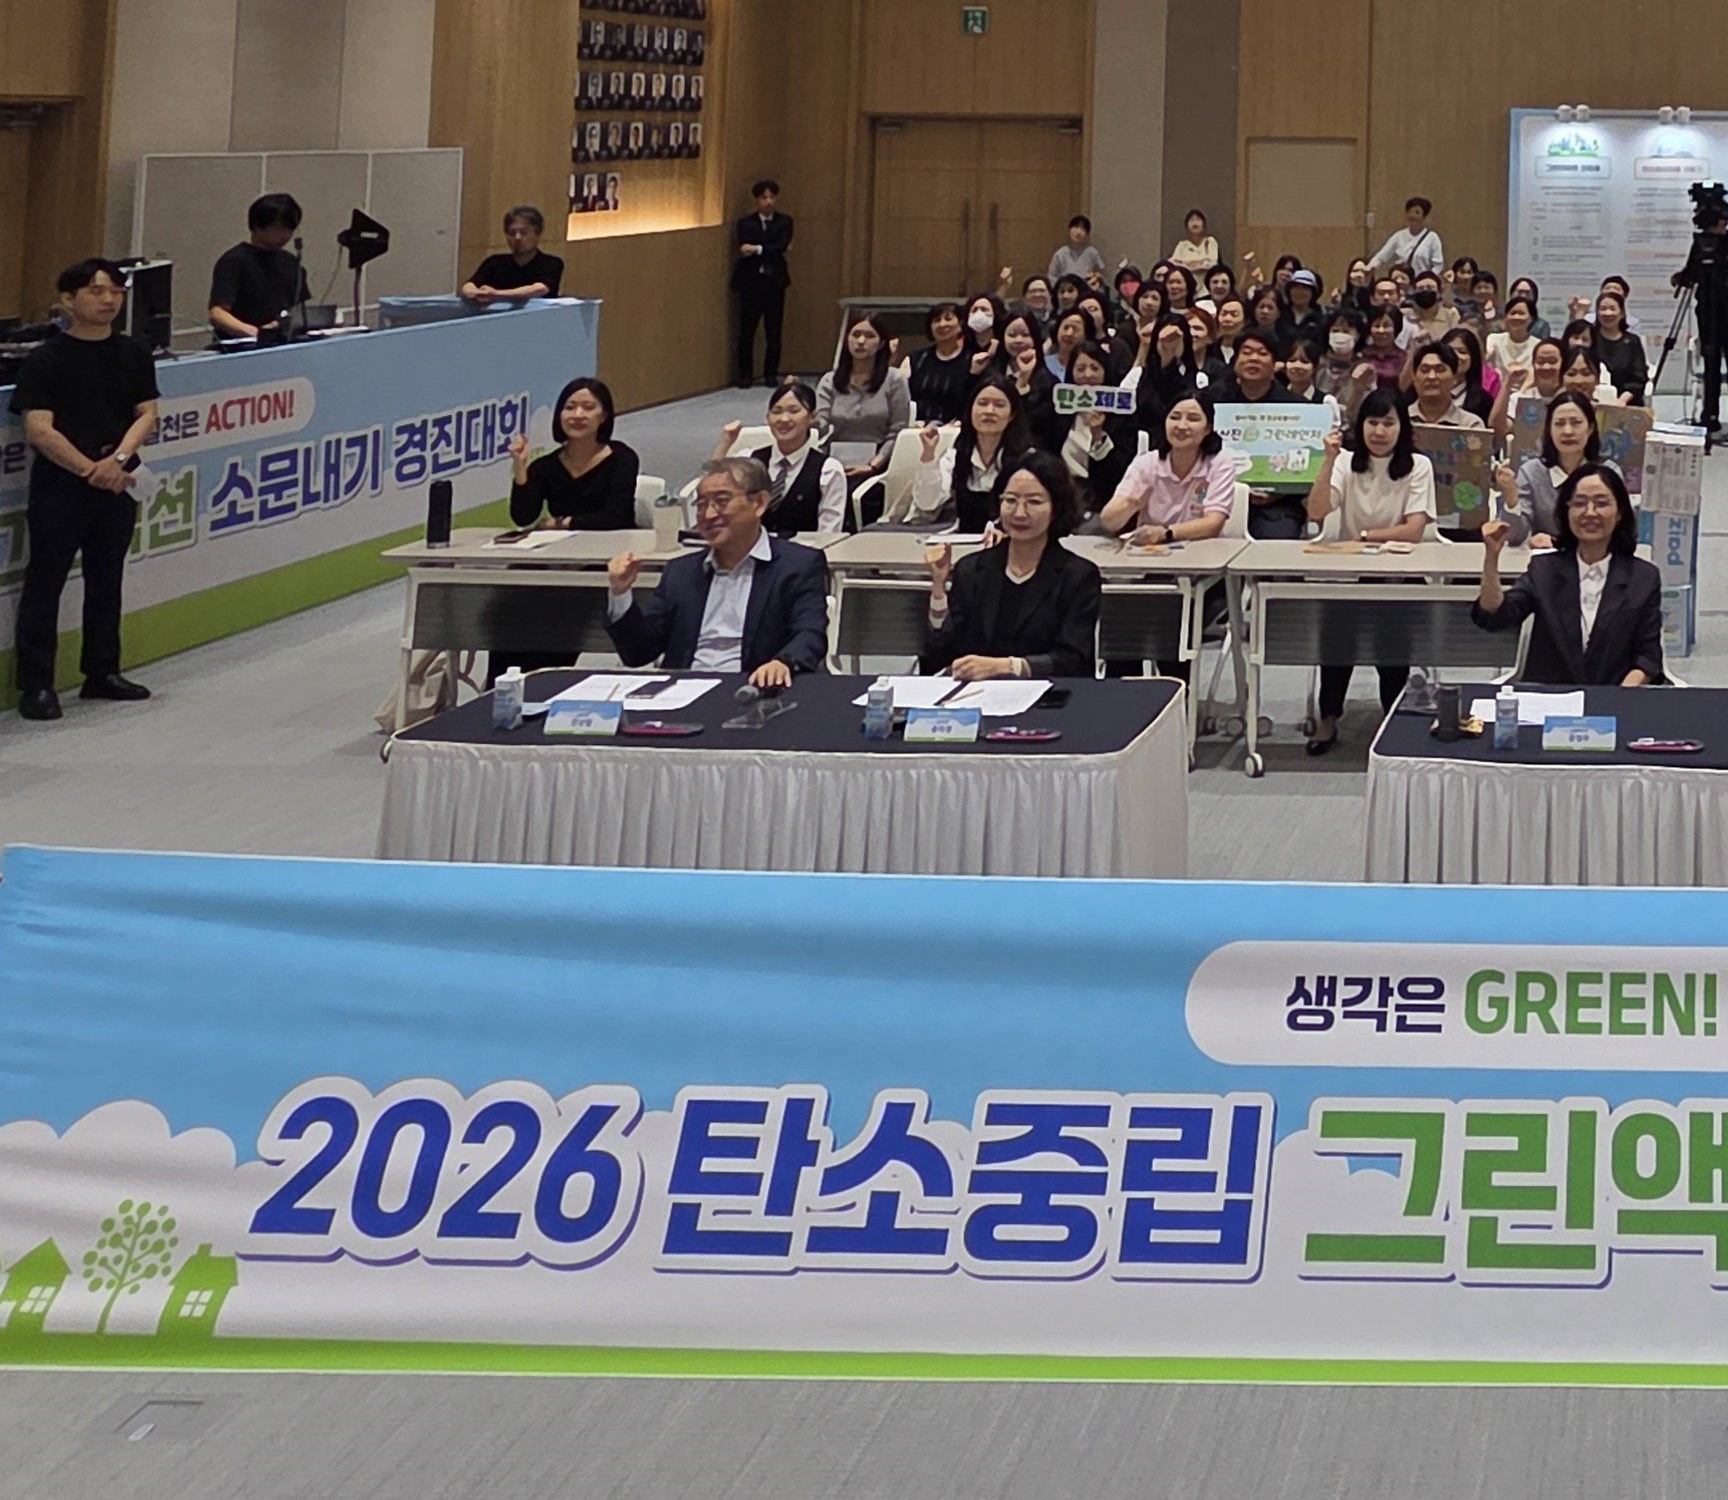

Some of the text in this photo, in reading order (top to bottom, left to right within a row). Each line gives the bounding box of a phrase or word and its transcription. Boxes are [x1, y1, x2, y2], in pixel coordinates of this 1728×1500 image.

[204, 388, 295, 434] ACTION!
[1056, 387, 1132, 411] 탄소제로
[208, 428, 381, 533] 소문내기
[394, 395, 527, 483] 경진대회
[1285, 974, 1447, 1033] 생각은
[1464, 970, 1718, 1037] GREEN!
[248, 1095, 622, 1243] 2026
[660, 1098, 1263, 1265] 탄소중립
